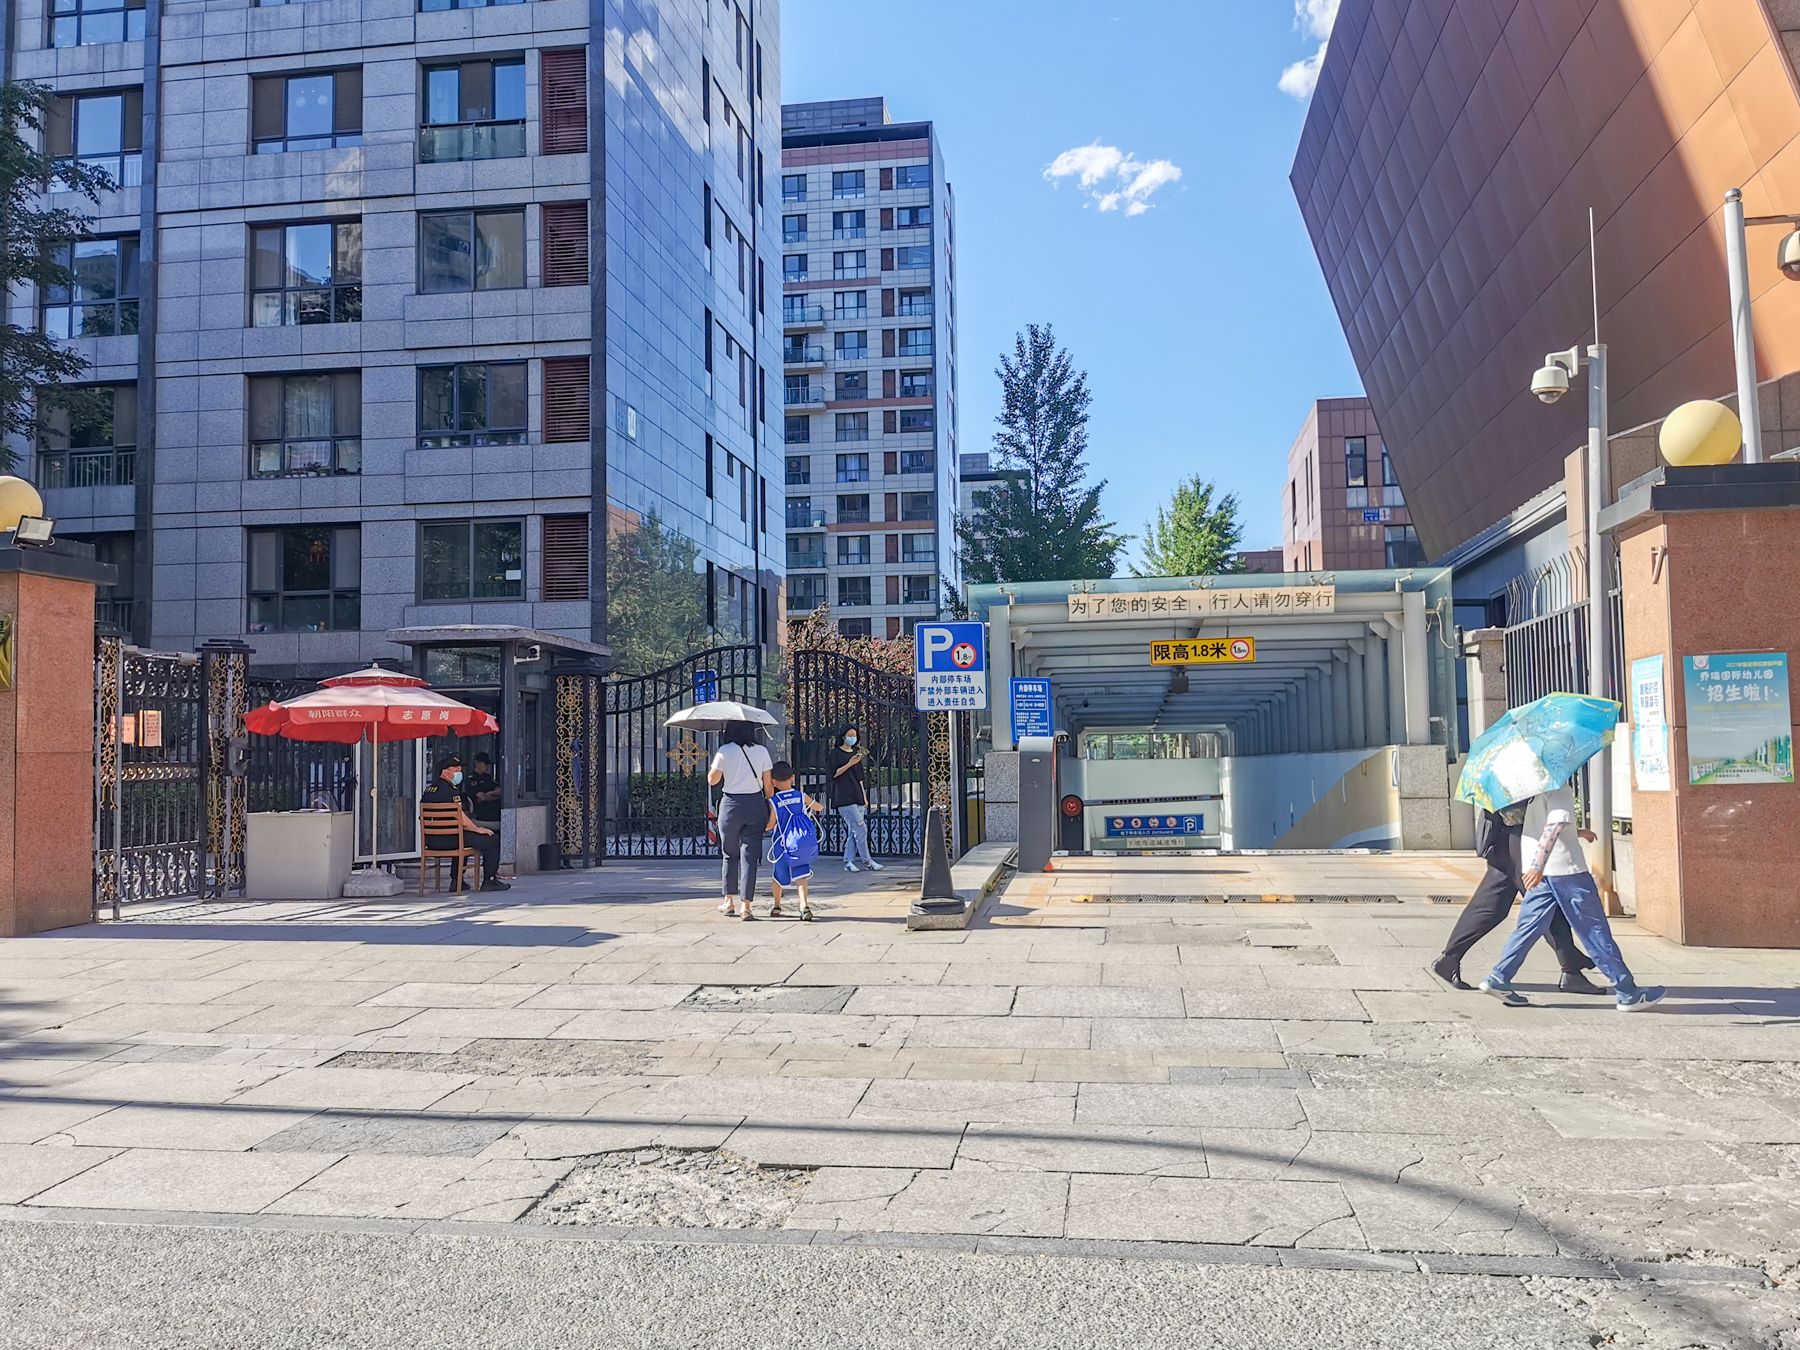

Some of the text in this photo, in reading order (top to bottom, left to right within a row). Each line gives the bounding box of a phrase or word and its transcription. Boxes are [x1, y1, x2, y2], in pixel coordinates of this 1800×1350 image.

[1071, 590, 1333, 614] 为了您的安全，行人请勿穿行
[923, 627, 954, 669] P
[1153, 642, 1227, 660] 限高1.8米
[931, 675, 972, 684] 内部停车场
[919, 686, 984, 696] 严禁外部车辆进入
[927, 697, 976, 707] 进入责任自负
[308, 709, 361, 719] 朝阳群众
